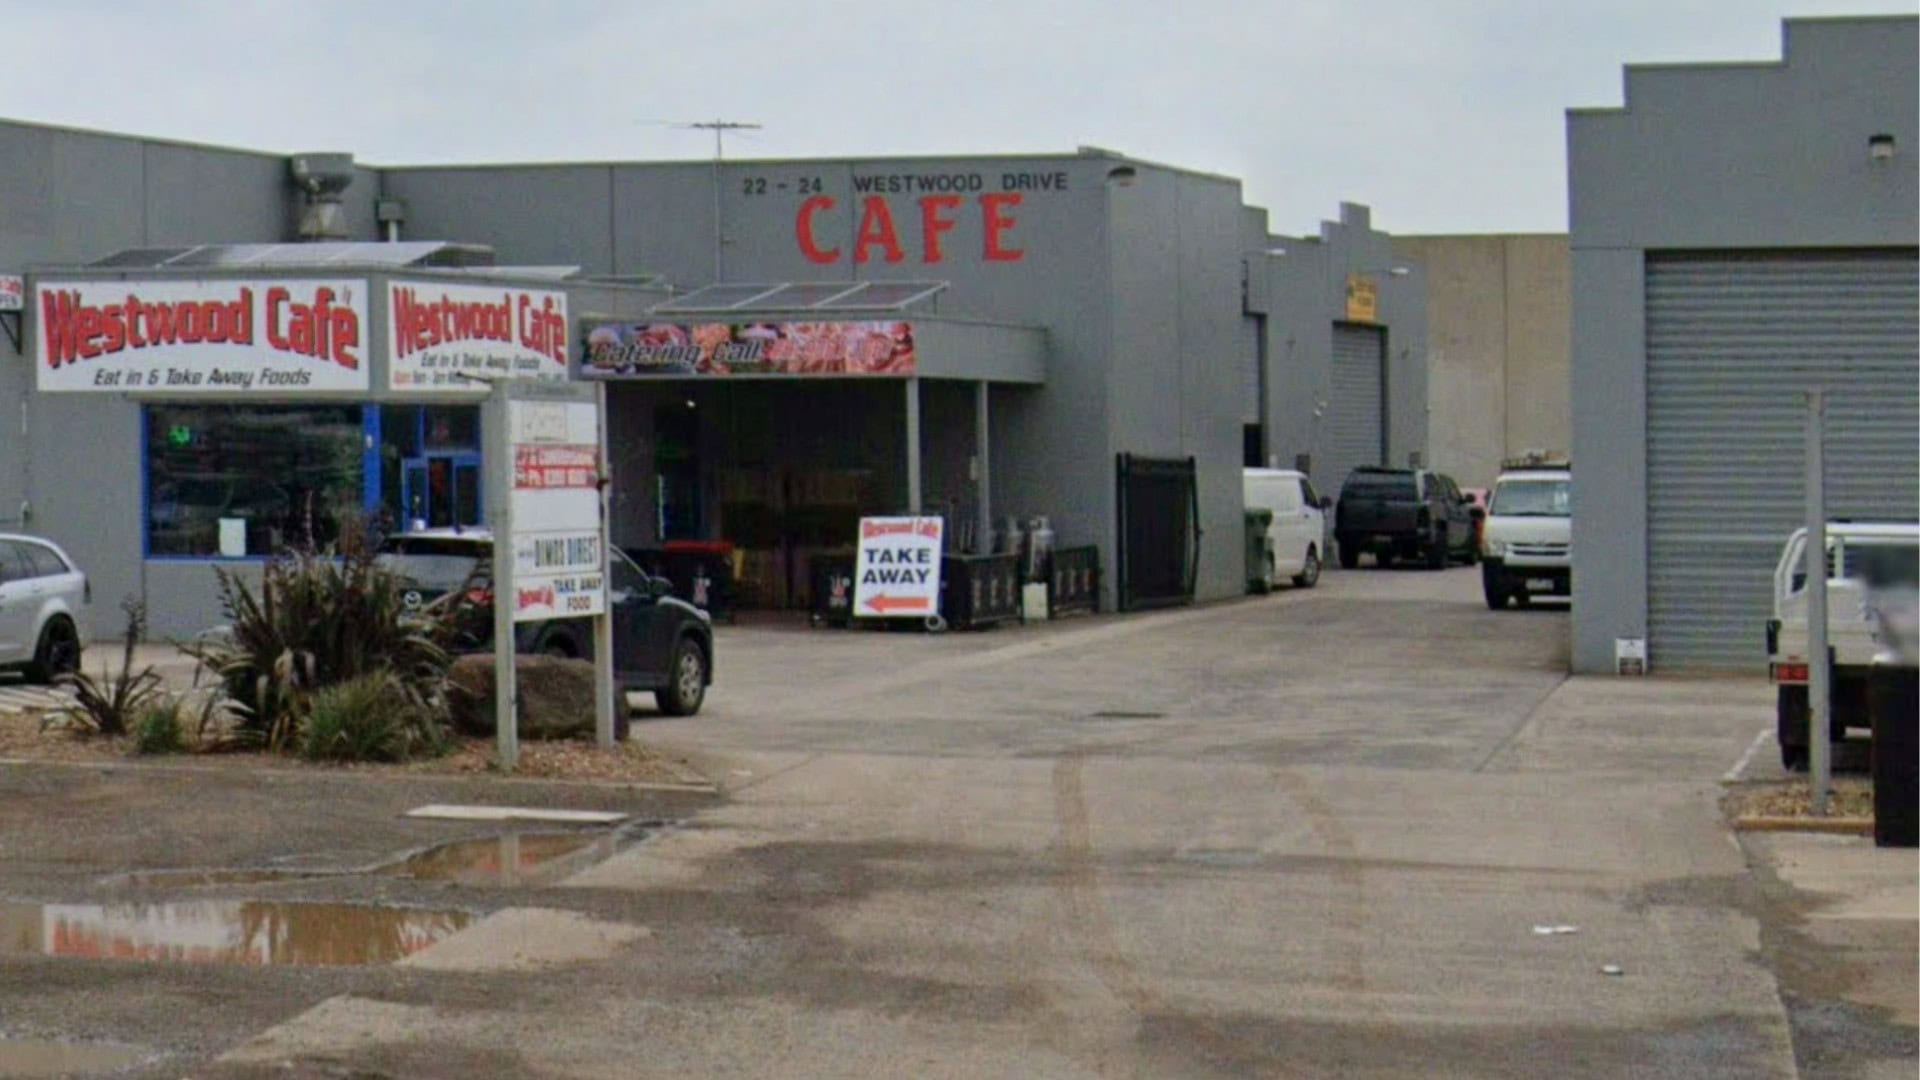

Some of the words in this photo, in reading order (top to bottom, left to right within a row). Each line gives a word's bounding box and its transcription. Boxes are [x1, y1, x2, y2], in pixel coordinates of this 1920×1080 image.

[743, 178, 767, 195] 22
[799, 177, 823, 193] 24
[853, 174, 983, 193] WESTWOOD
[1002, 172, 1068, 191] DRIVE
[795, 192, 1025, 265] CAFE
[42, 287, 253, 369] Westwood
[393, 285, 513, 360] Westwood
[591, 340, 702, 367] Catering
[711, 338, 764, 364] Call
[94, 368, 121, 386] Eat
[126, 369, 142, 386] in
[166, 368, 201, 386] Take
[207, 368, 254, 388] Away
[259, 367, 311, 385] Foods
[864, 548, 931, 563] TAKE
[863, 568, 931, 584] AWAY
